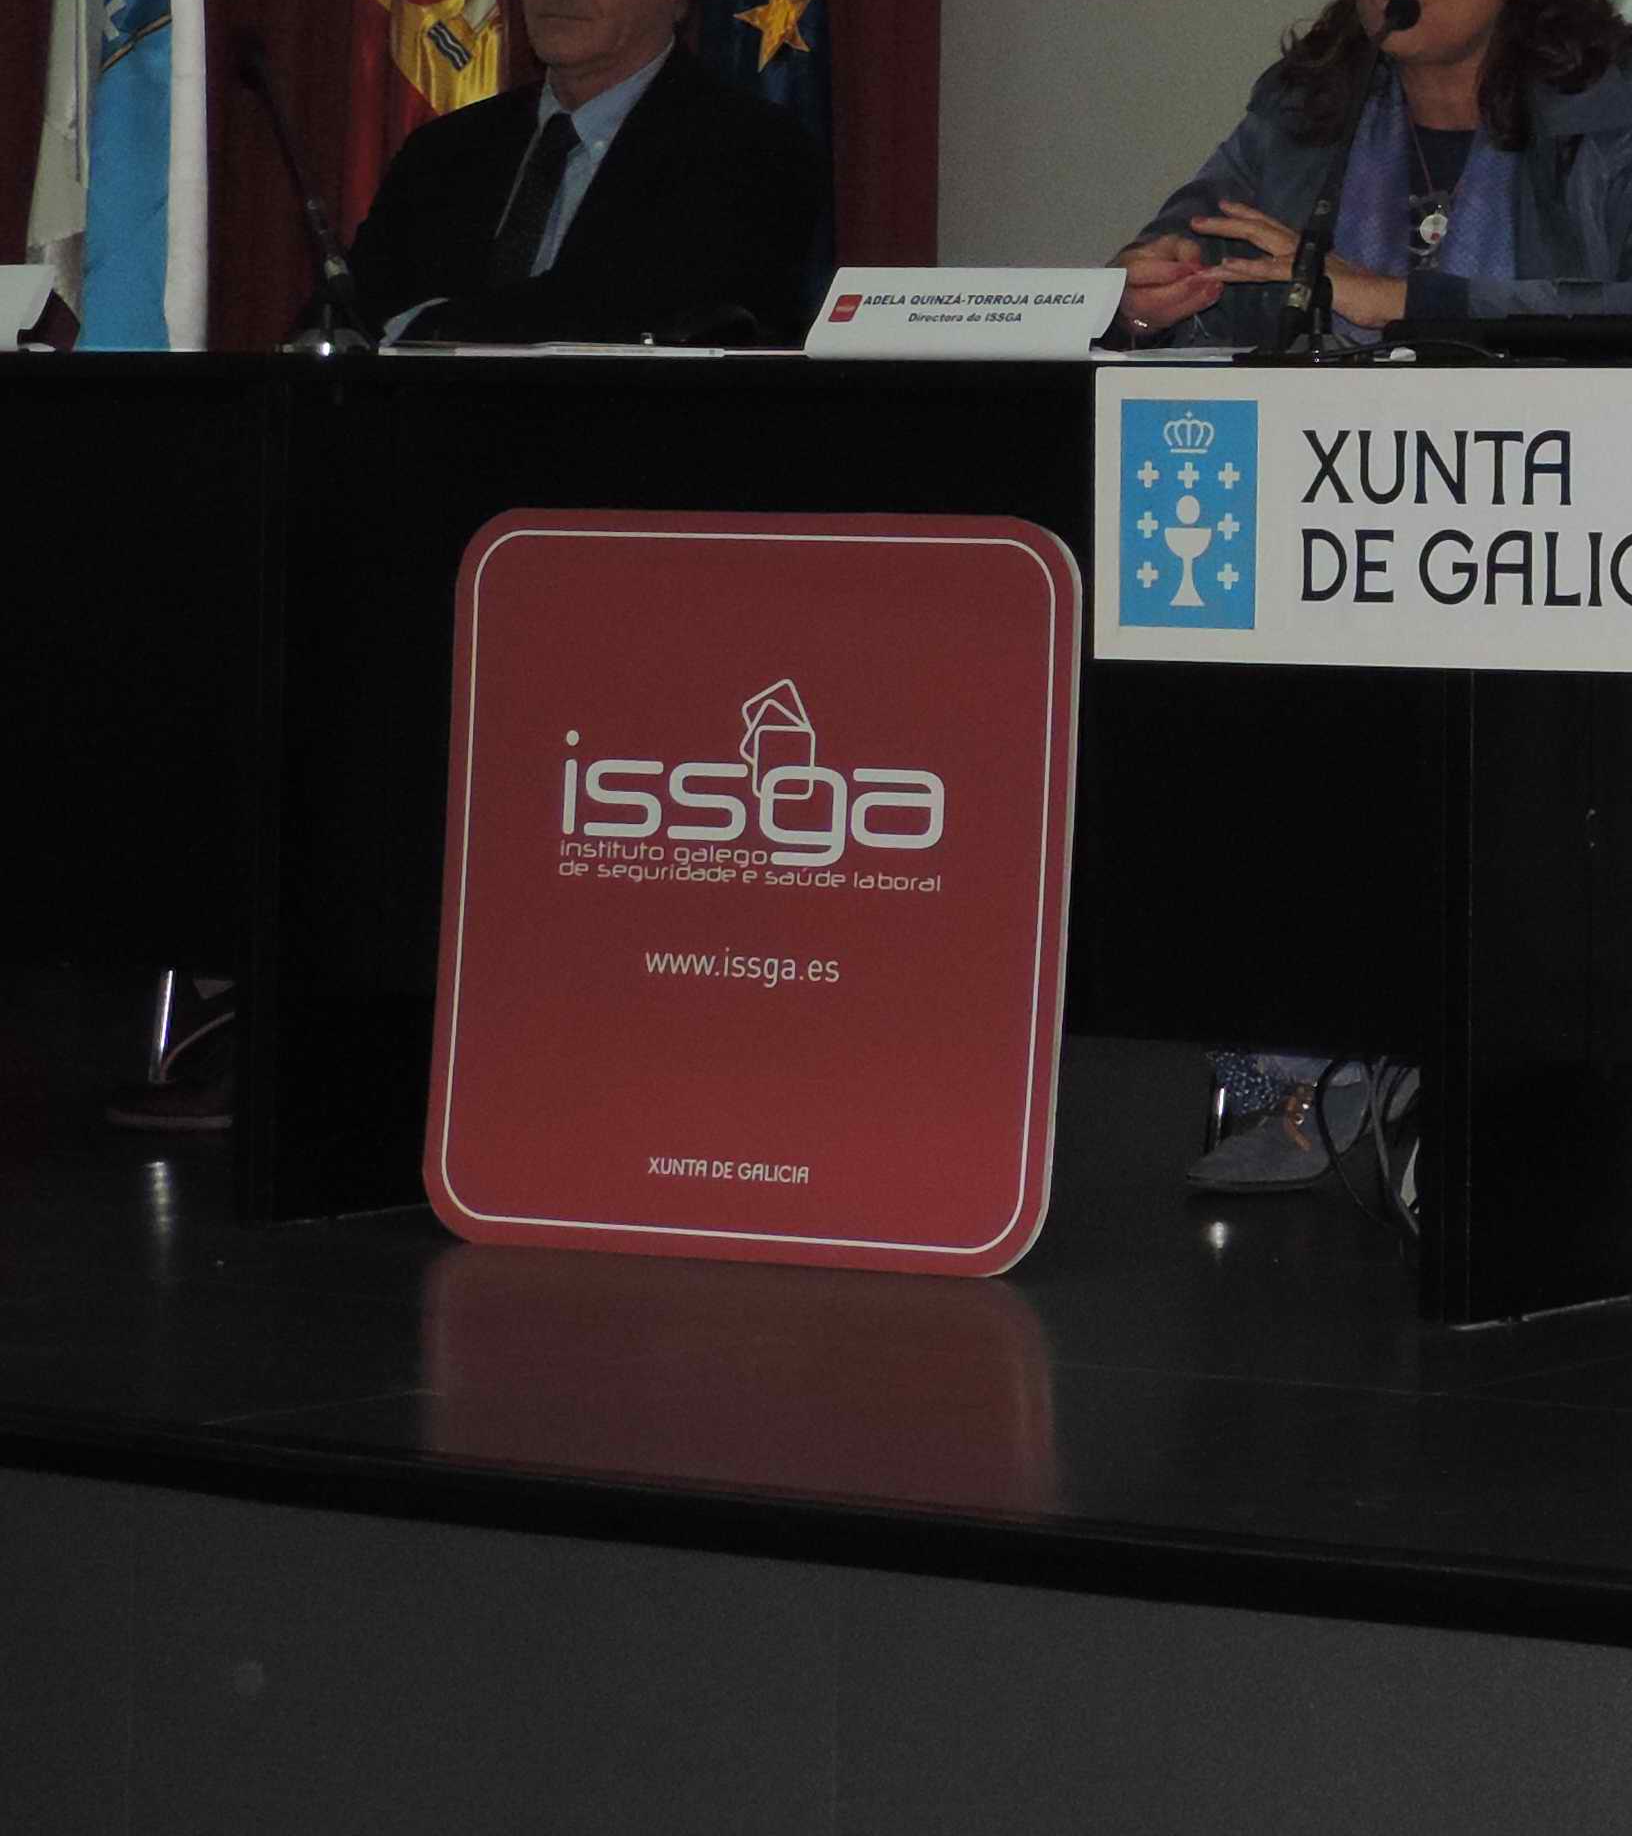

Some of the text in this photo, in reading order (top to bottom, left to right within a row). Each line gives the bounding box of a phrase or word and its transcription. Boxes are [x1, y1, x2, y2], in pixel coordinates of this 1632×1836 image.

[863, 294, 906, 305] ADELA
[1033, 292, 1085, 305] GARCÍA
[908, 312, 963, 322] Directora
[985, 312, 1022, 322] ISSGA
[1302, 428, 1573, 506] XUNTA
[1301, 528, 1395, 603] DE
[561, 728, 946, 868] issga
[559, 839, 769, 869] instituto galego
[558, 860, 942, 893] de seguridade e saúde laboral
[644, 946, 841, 989] www.issga.es
[648, 1155, 810, 1185] XUNTA DE GALICIA
